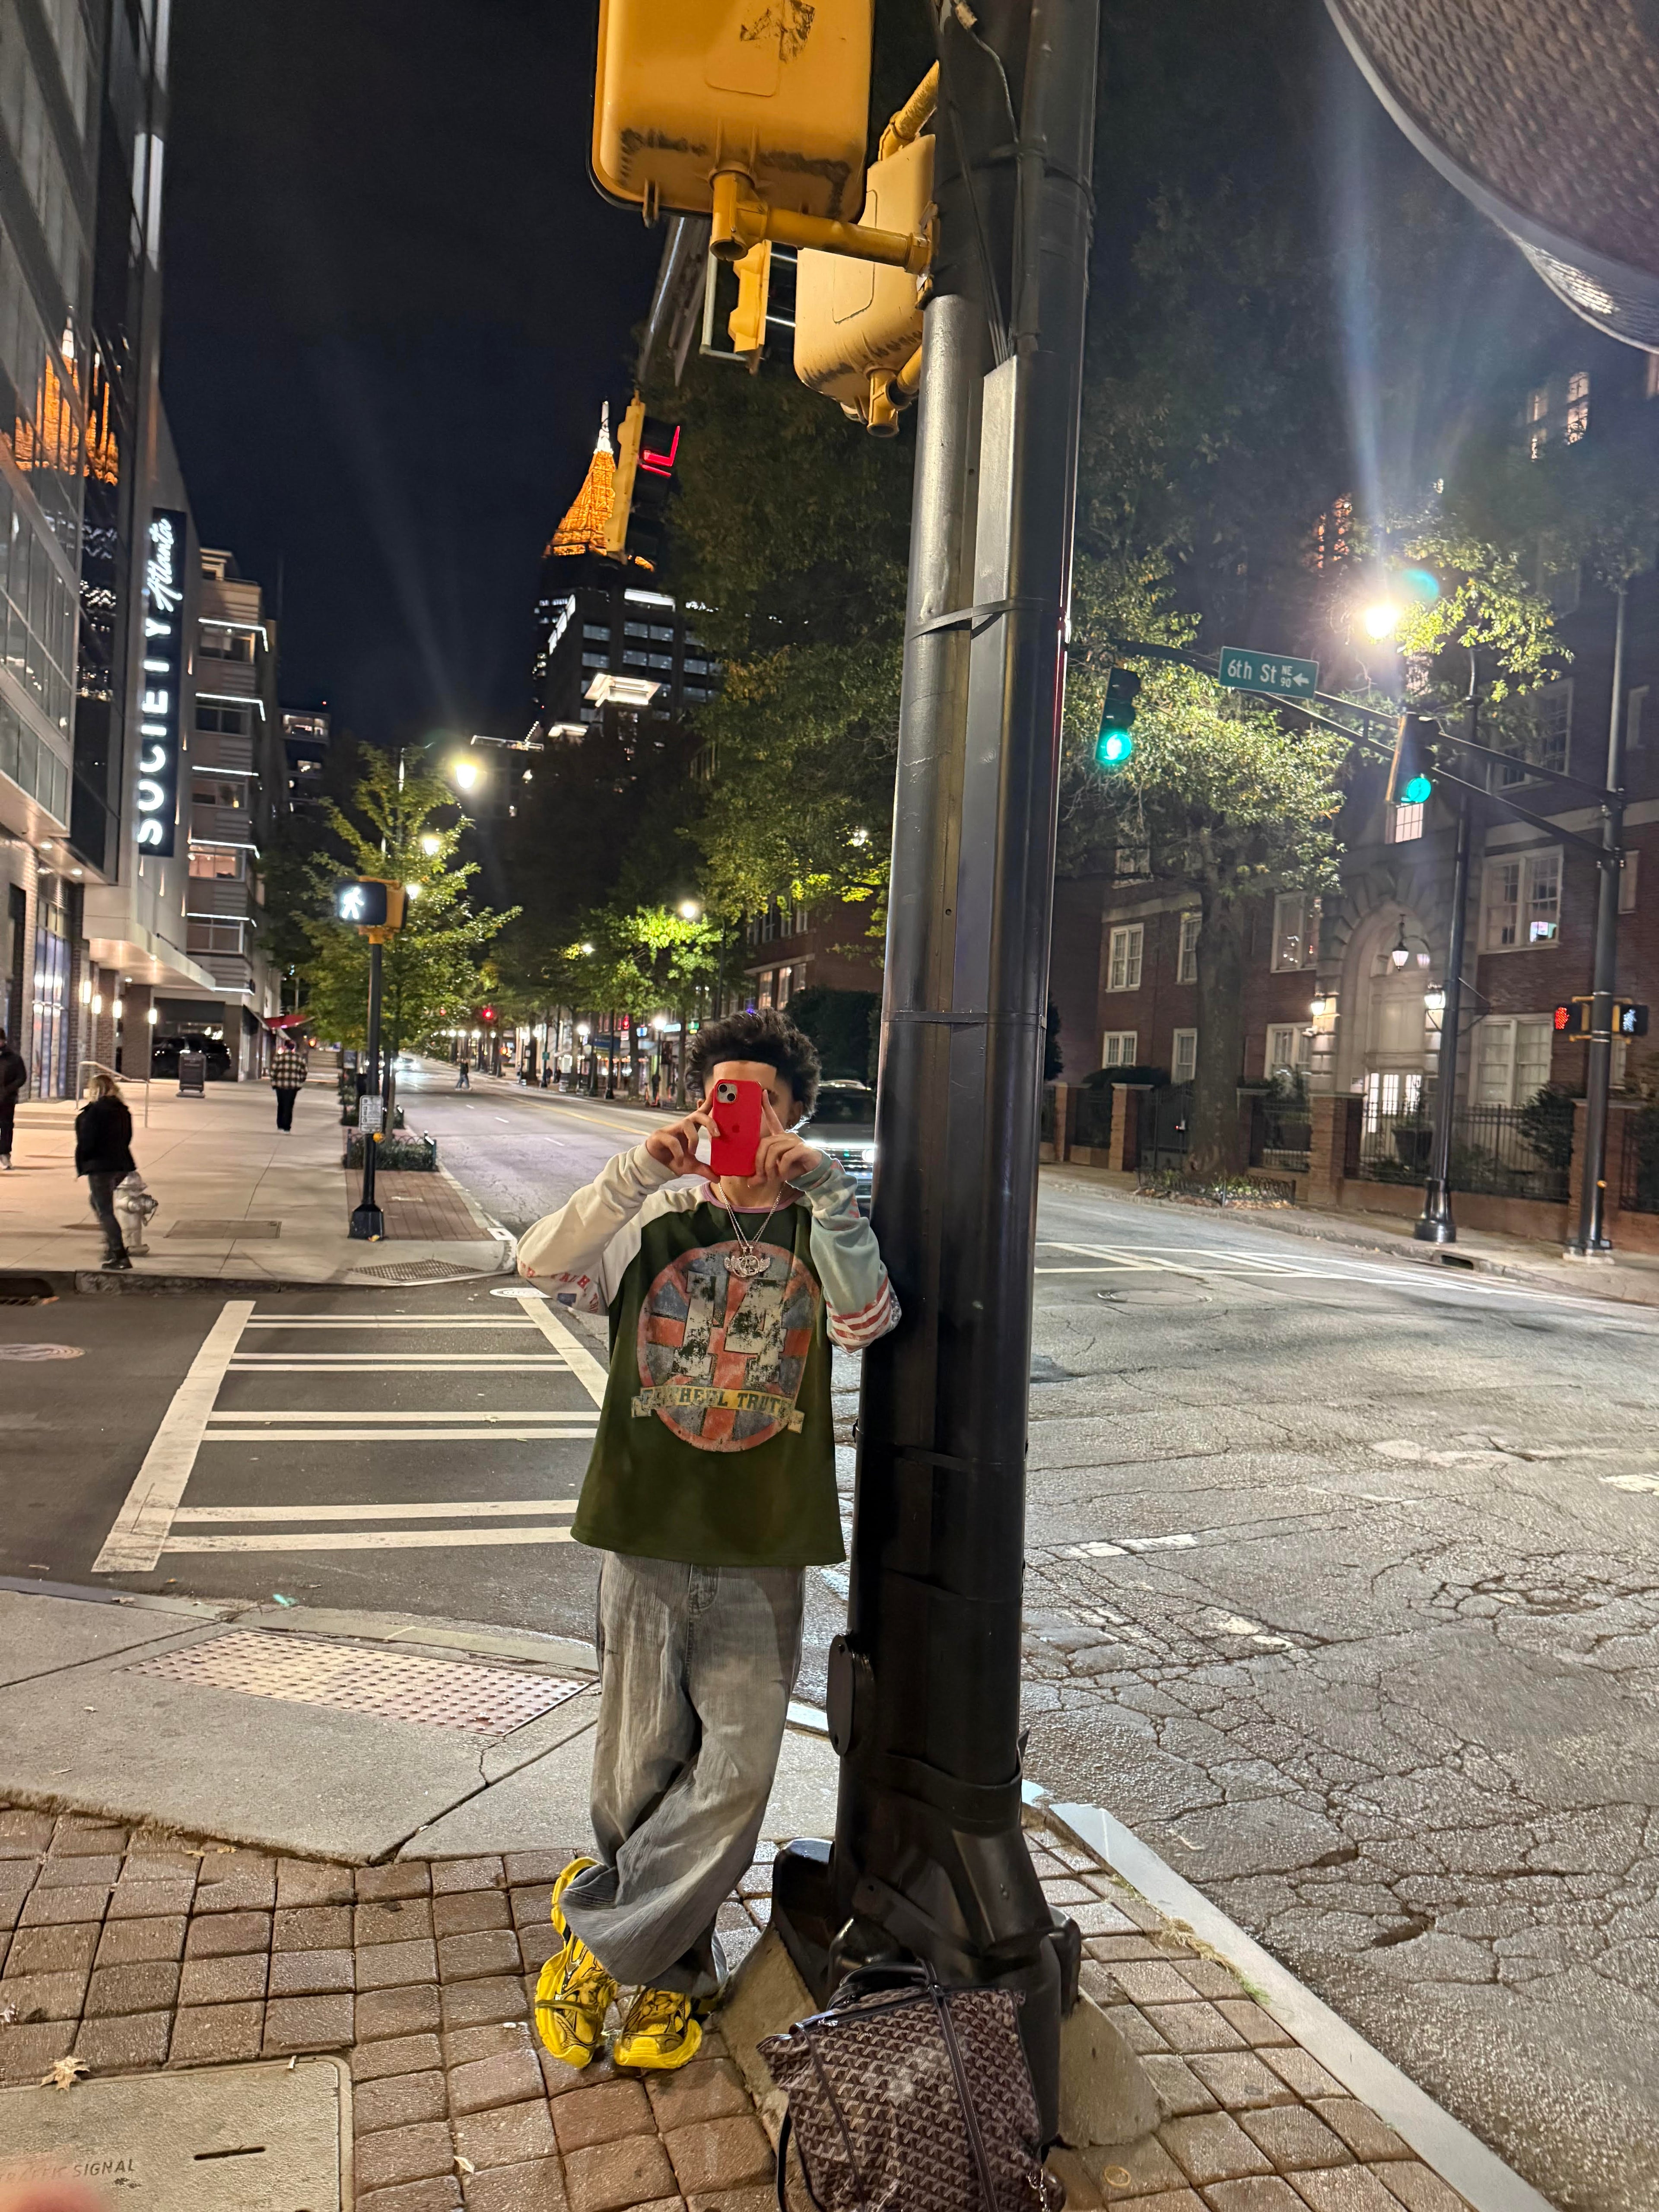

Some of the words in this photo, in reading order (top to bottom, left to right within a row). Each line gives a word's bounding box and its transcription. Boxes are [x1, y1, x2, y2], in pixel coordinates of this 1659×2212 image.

[147, 518, 183, 612] Atlanta
[1227, 659, 1252, 680] 6th
[1260, 664, 1277, 683] St
[1281, 665, 1293, 676] NE
[1280, 677, 1291, 688] 90
[72, 2159, 135, 2178] SIGNAL
